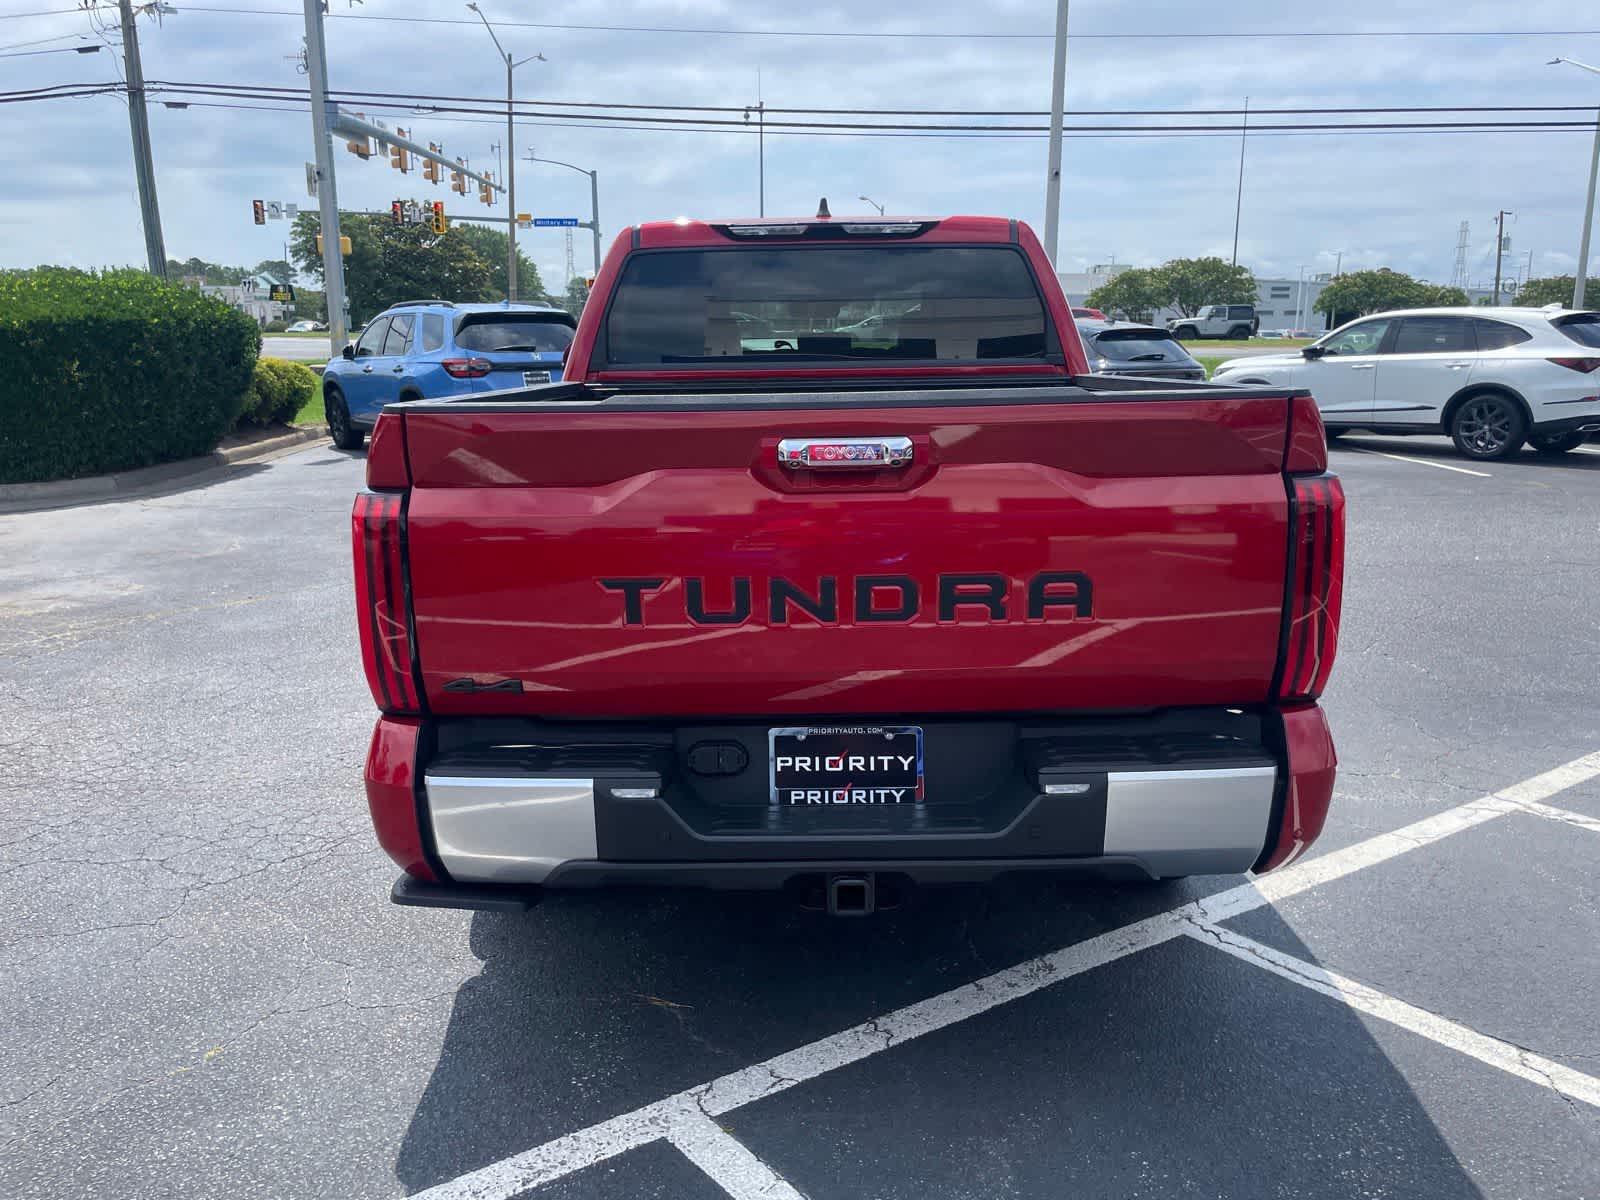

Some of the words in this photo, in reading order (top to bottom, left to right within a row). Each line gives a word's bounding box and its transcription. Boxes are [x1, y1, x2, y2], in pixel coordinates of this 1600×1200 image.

[815, 446, 877, 460] TOYOTA
[597, 570, 1095, 627] TUNDRA
[776, 755, 915, 772] PRIORITY
[790, 789, 906, 805] PRIORITY
